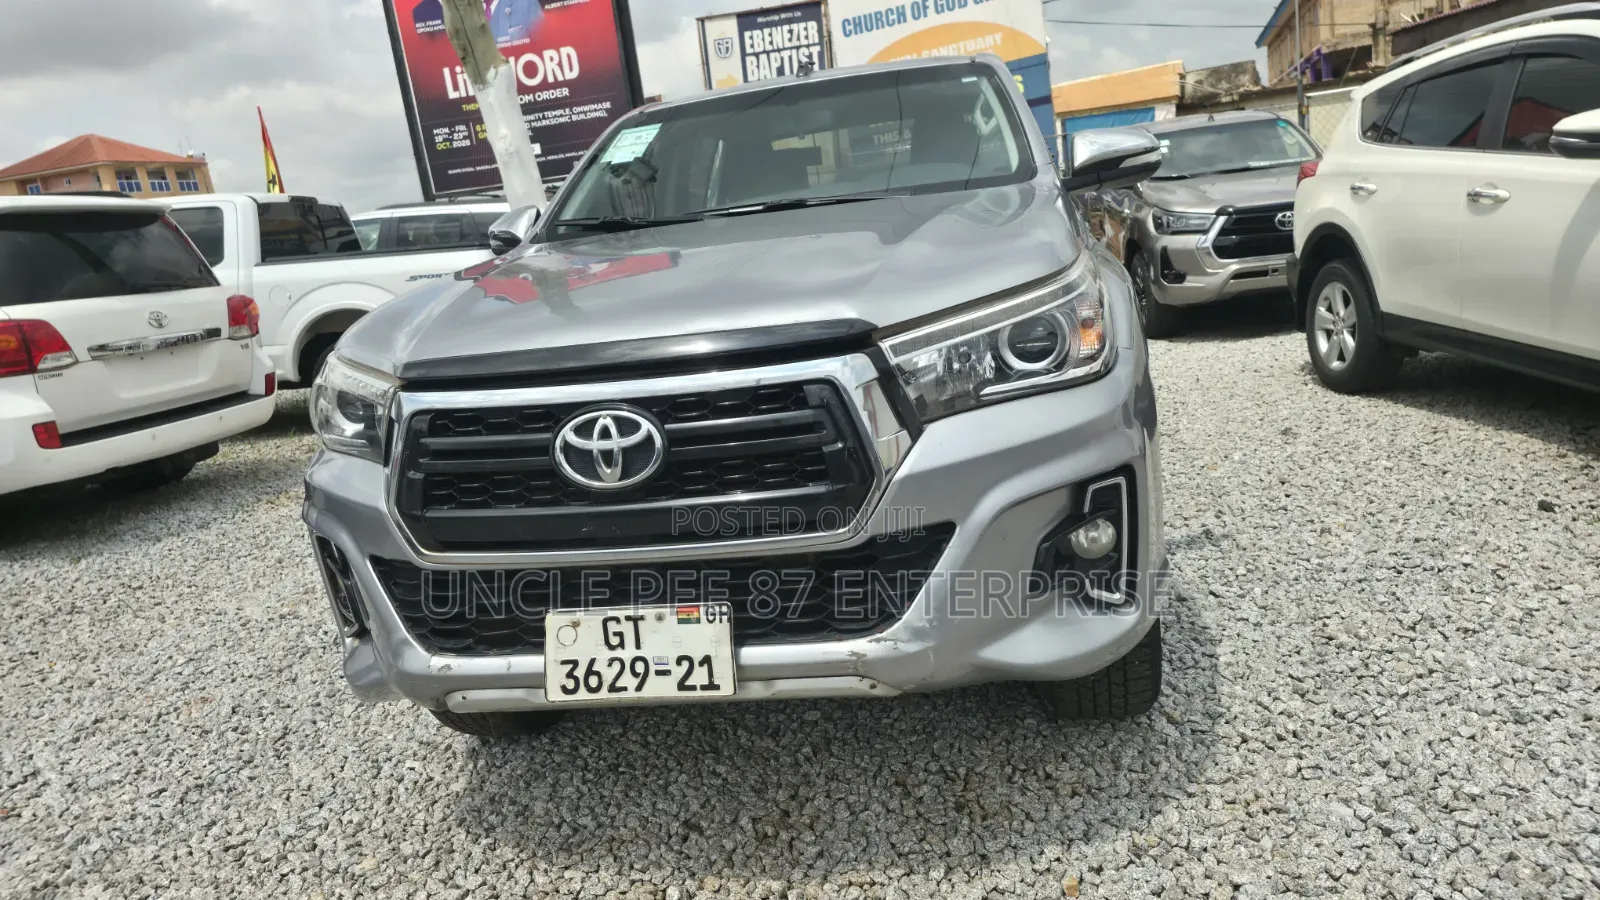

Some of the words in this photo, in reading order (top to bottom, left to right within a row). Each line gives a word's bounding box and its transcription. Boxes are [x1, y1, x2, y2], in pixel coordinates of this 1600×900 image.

[757, 14, 780, 23] Worship
[841, 4, 908, 38] CHURCH
[910, 0, 930, 21] OF
[744, 21, 819, 54] EBENEZER
[921, 31, 1003, 59] SANCTUARY
[745, 45, 821, 82] BAPTIST
[535, 87, 570, 100] ORDER
[532, 116, 571, 128] MARKSONIC
[543, 108, 572, 119] TEMPLE,
[433, 126, 450, 135] MON.
[455, 124, 468, 132] FRI.
[436, 142, 452, 150] OCT.
[602, 614, 646, 651] GT
[705, 605, 731, 624] GH
[559, 654, 721, 695] 3629-21
